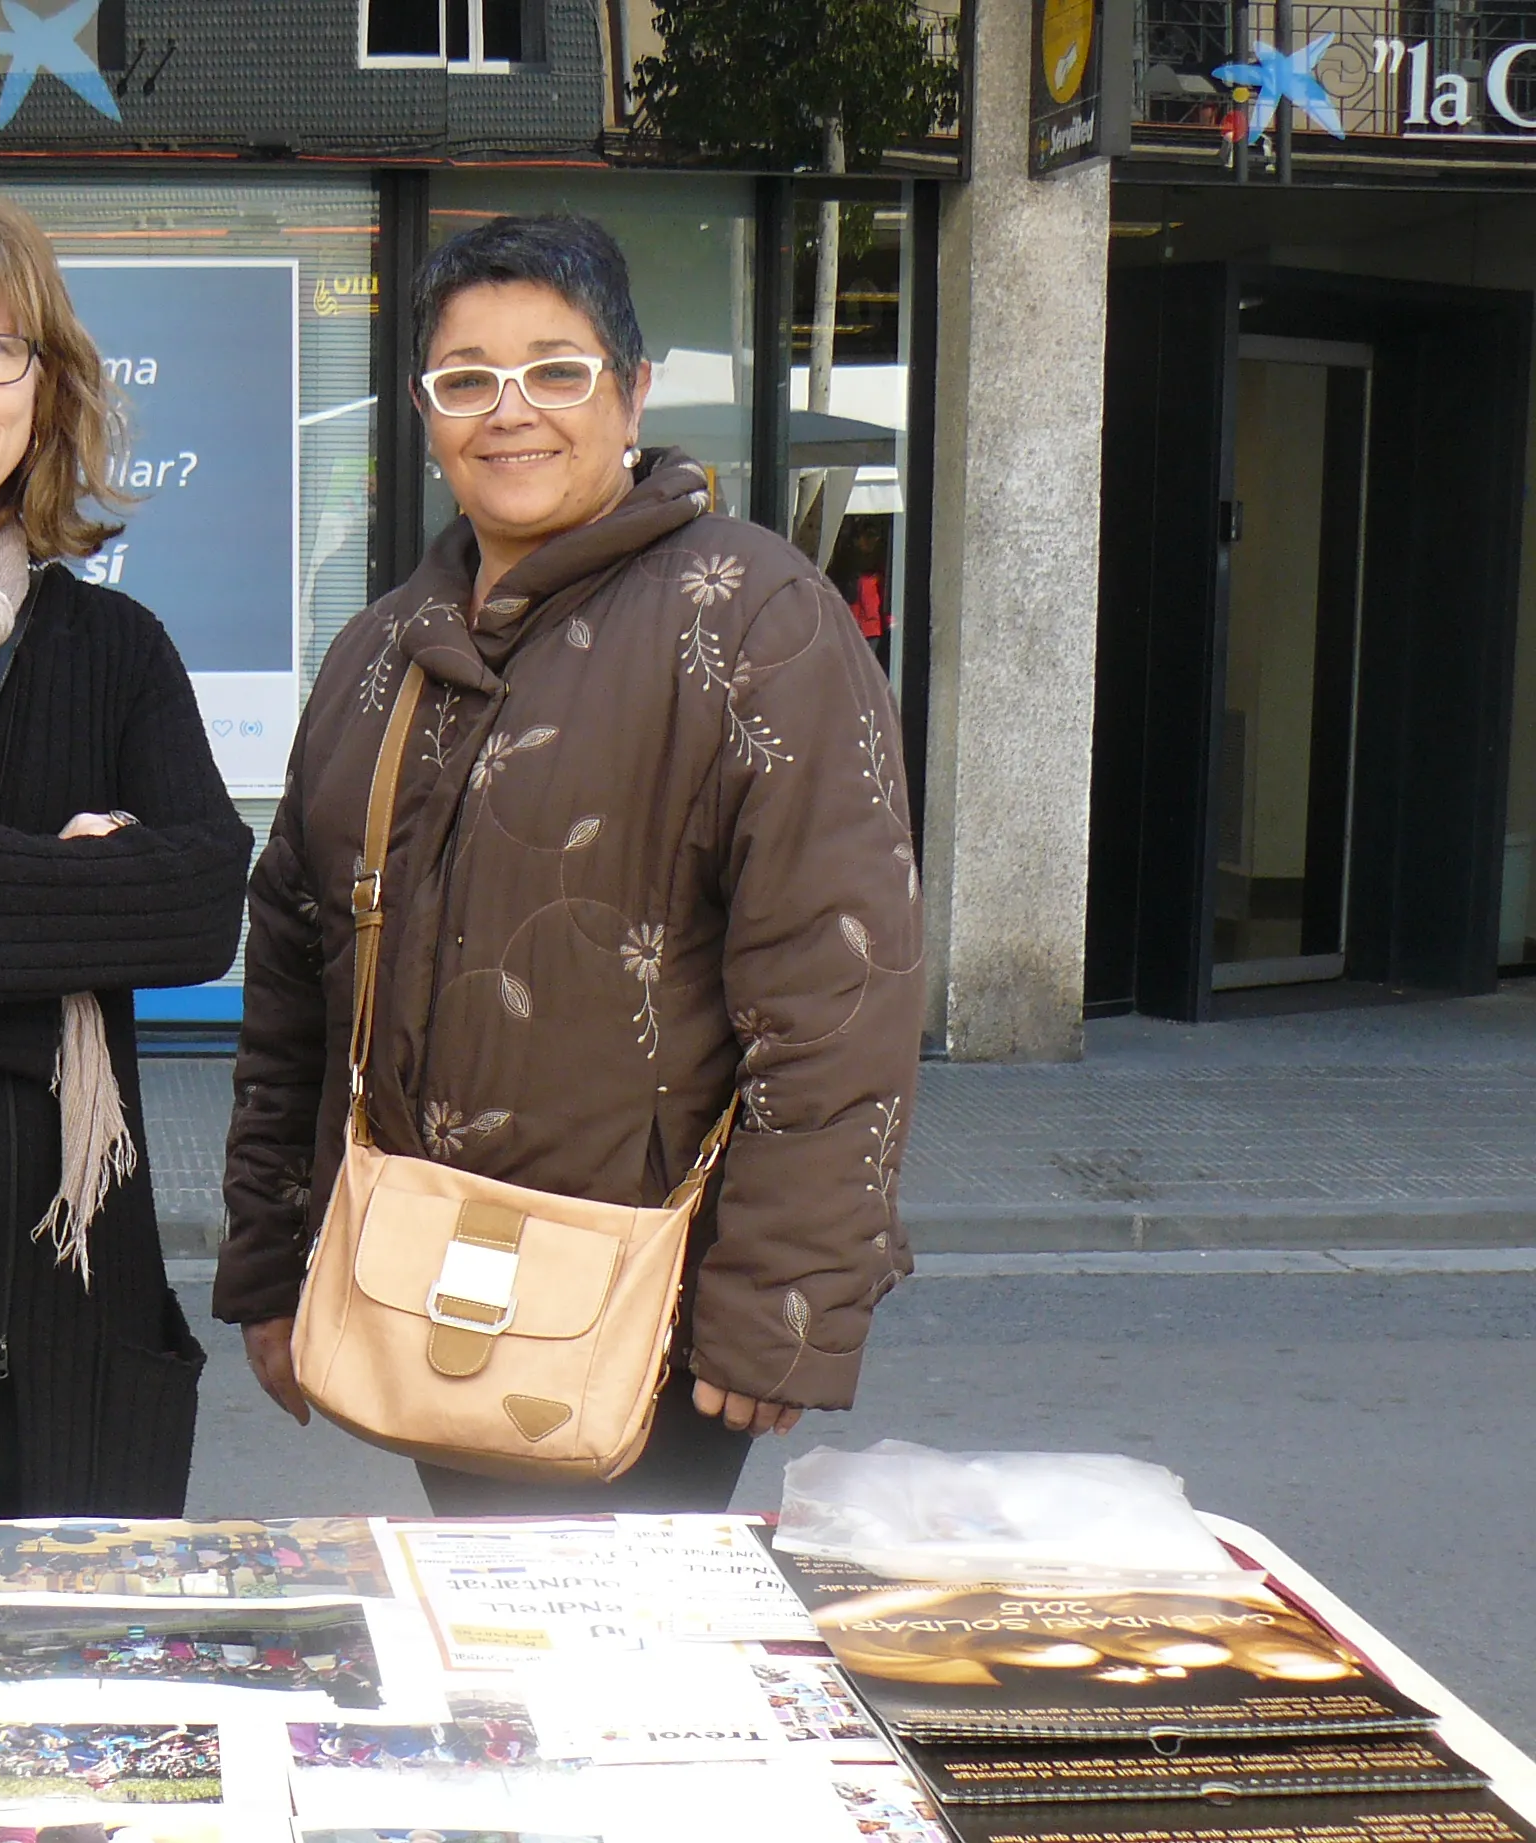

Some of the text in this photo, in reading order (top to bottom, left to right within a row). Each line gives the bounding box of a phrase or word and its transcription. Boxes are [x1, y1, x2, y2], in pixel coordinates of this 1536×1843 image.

[1049, 110, 1095, 157] ServiRed
[1000, 1601, 1094, 1616] 2015
[837, 1614, 1276, 1633] CALENDARI SOLIDARI
